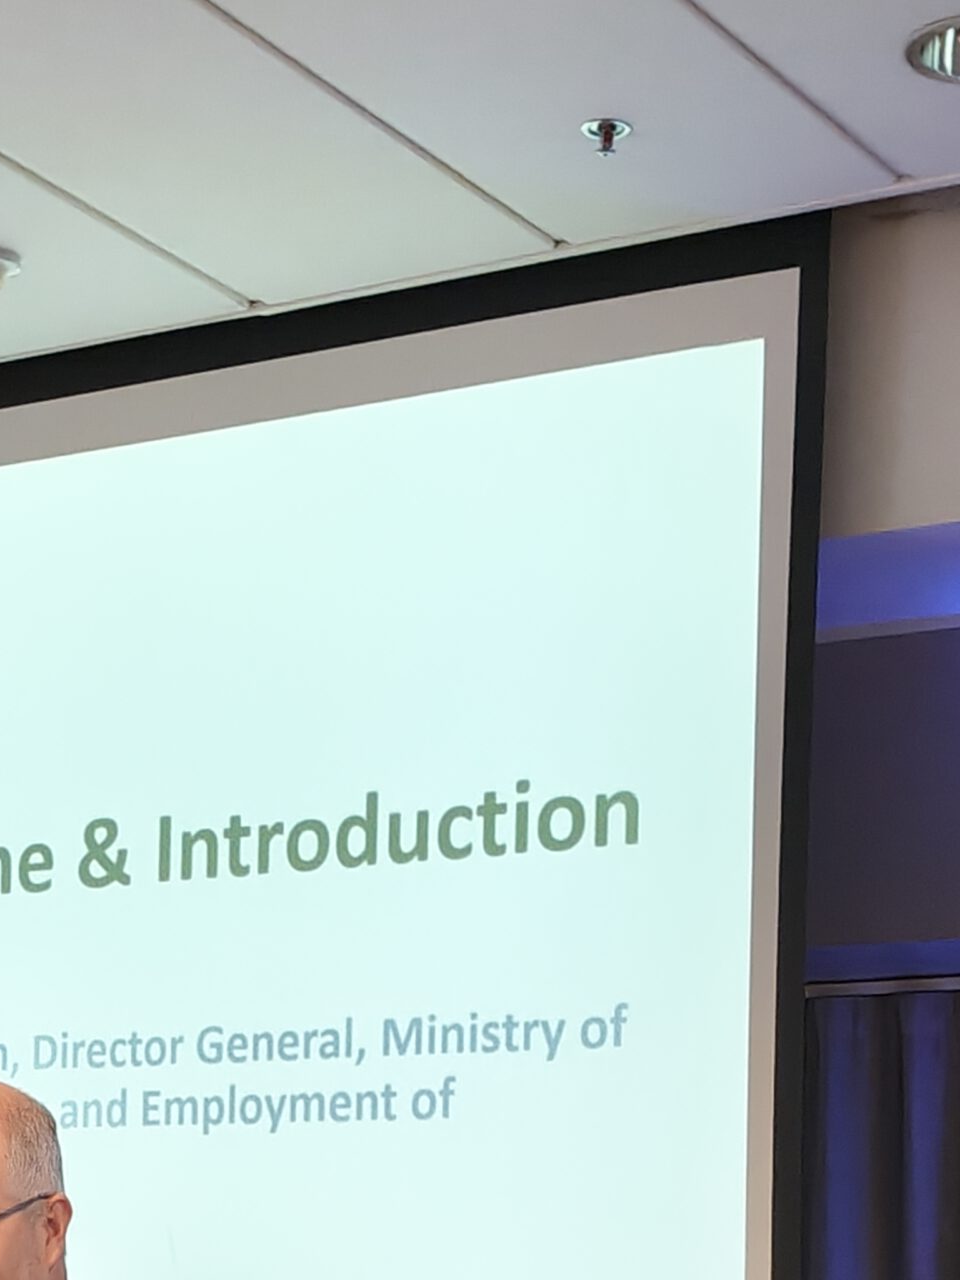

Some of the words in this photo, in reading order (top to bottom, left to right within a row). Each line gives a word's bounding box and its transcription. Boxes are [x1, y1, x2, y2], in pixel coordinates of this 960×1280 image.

[76, 817, 131, 889] &
[158, 779, 640, 883] Introduction
[33, 1026, 185, 1070] Director
[196, 1014, 366, 1067] General,
[382, 1008, 566, 1061] Ministry
[580, 1002, 629, 1049] of
[59, 1088, 127, 1129] and
[142, 1083, 398, 1136] Employment
[411, 1076, 457, 1120] of
